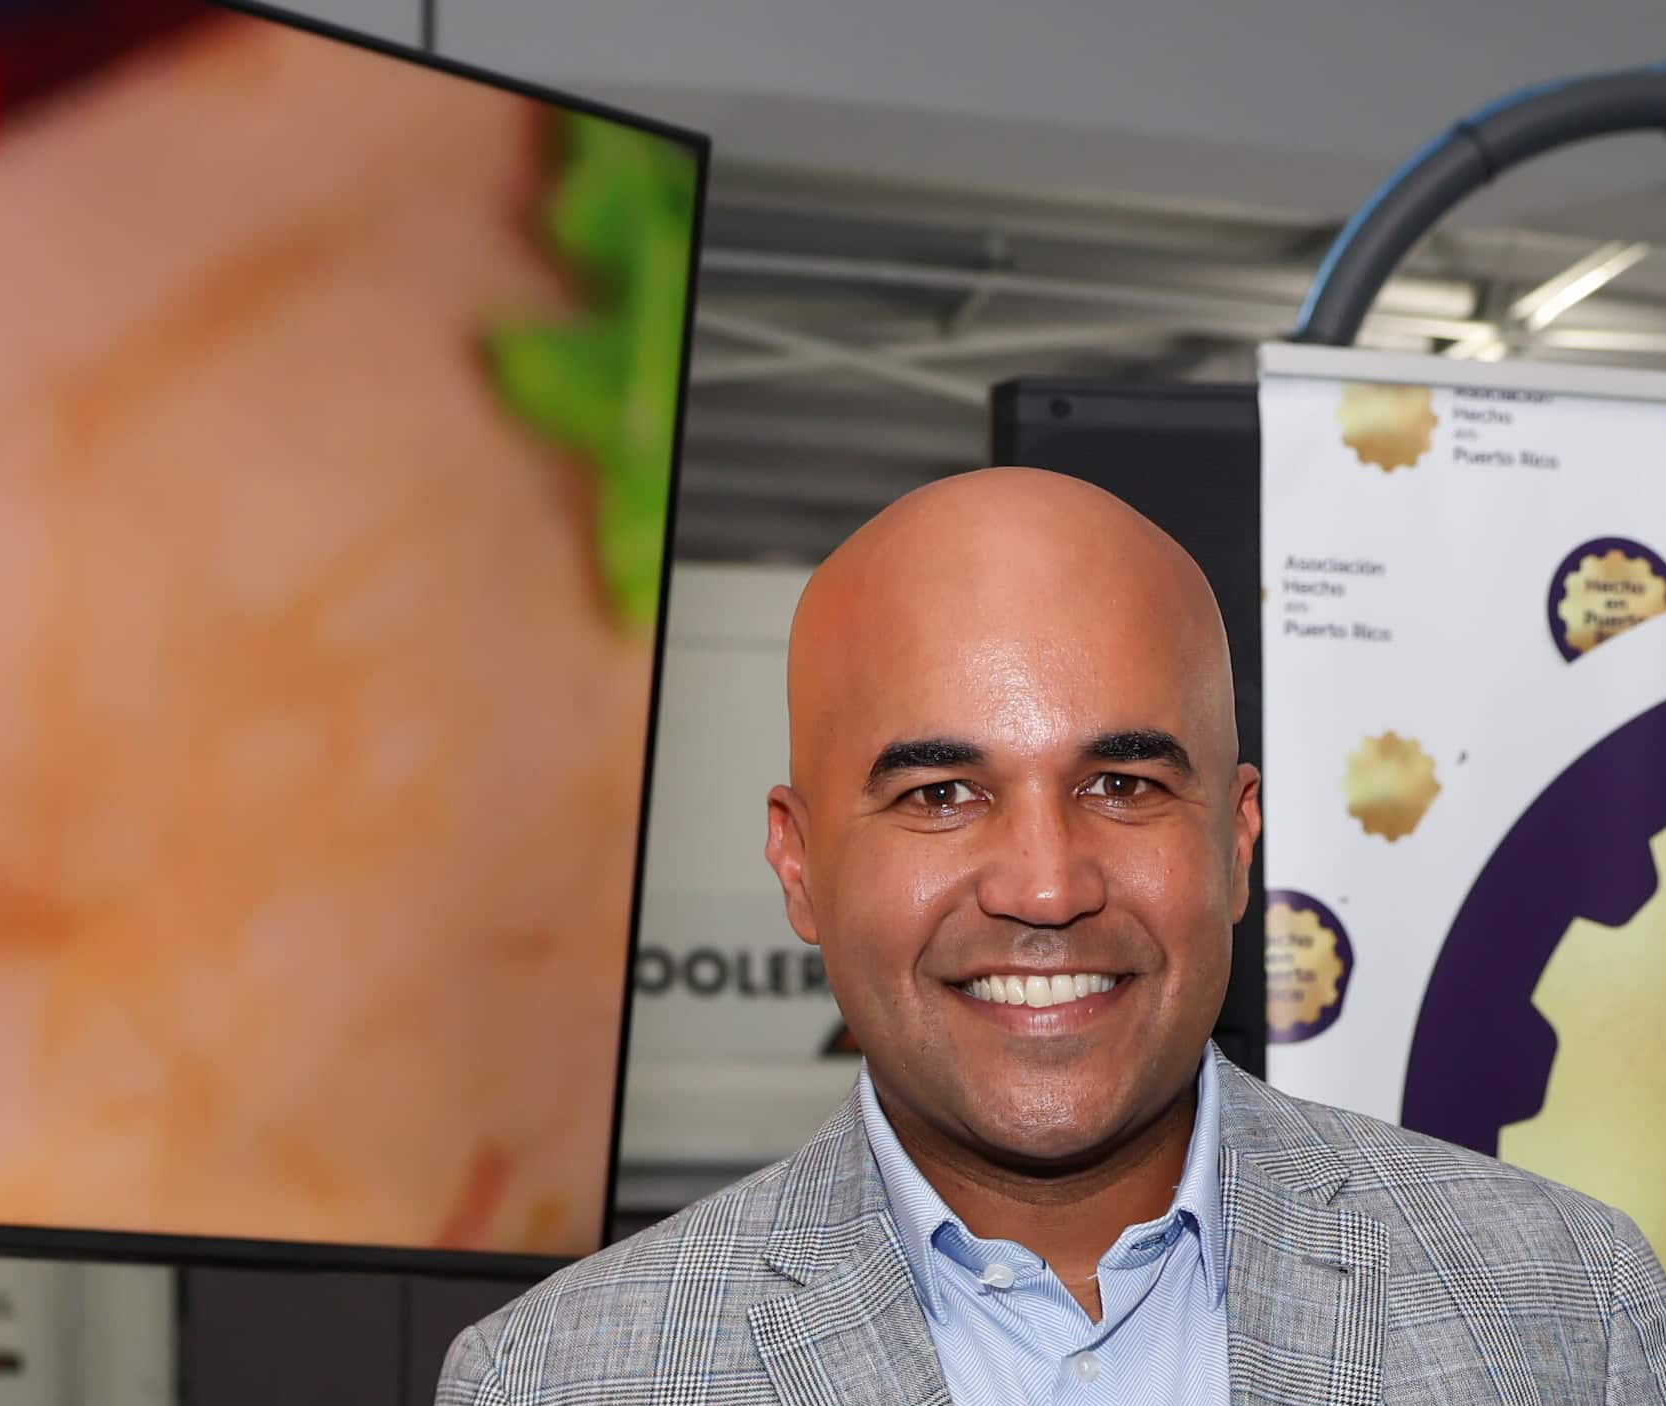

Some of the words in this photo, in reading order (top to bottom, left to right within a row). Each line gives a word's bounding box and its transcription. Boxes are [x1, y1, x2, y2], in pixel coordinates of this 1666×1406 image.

[1452, 408, 1511, 423] Hecho
[1453, 447, 1515, 465] Puerto
[1519, 450, 1560, 469] Rico
[1284, 581, 1346, 597] Hecho
[1585, 580, 1645, 594] Hecho
[1284, 620, 1347, 638] Puerto
[1352, 624, 1392, 642] Rico
